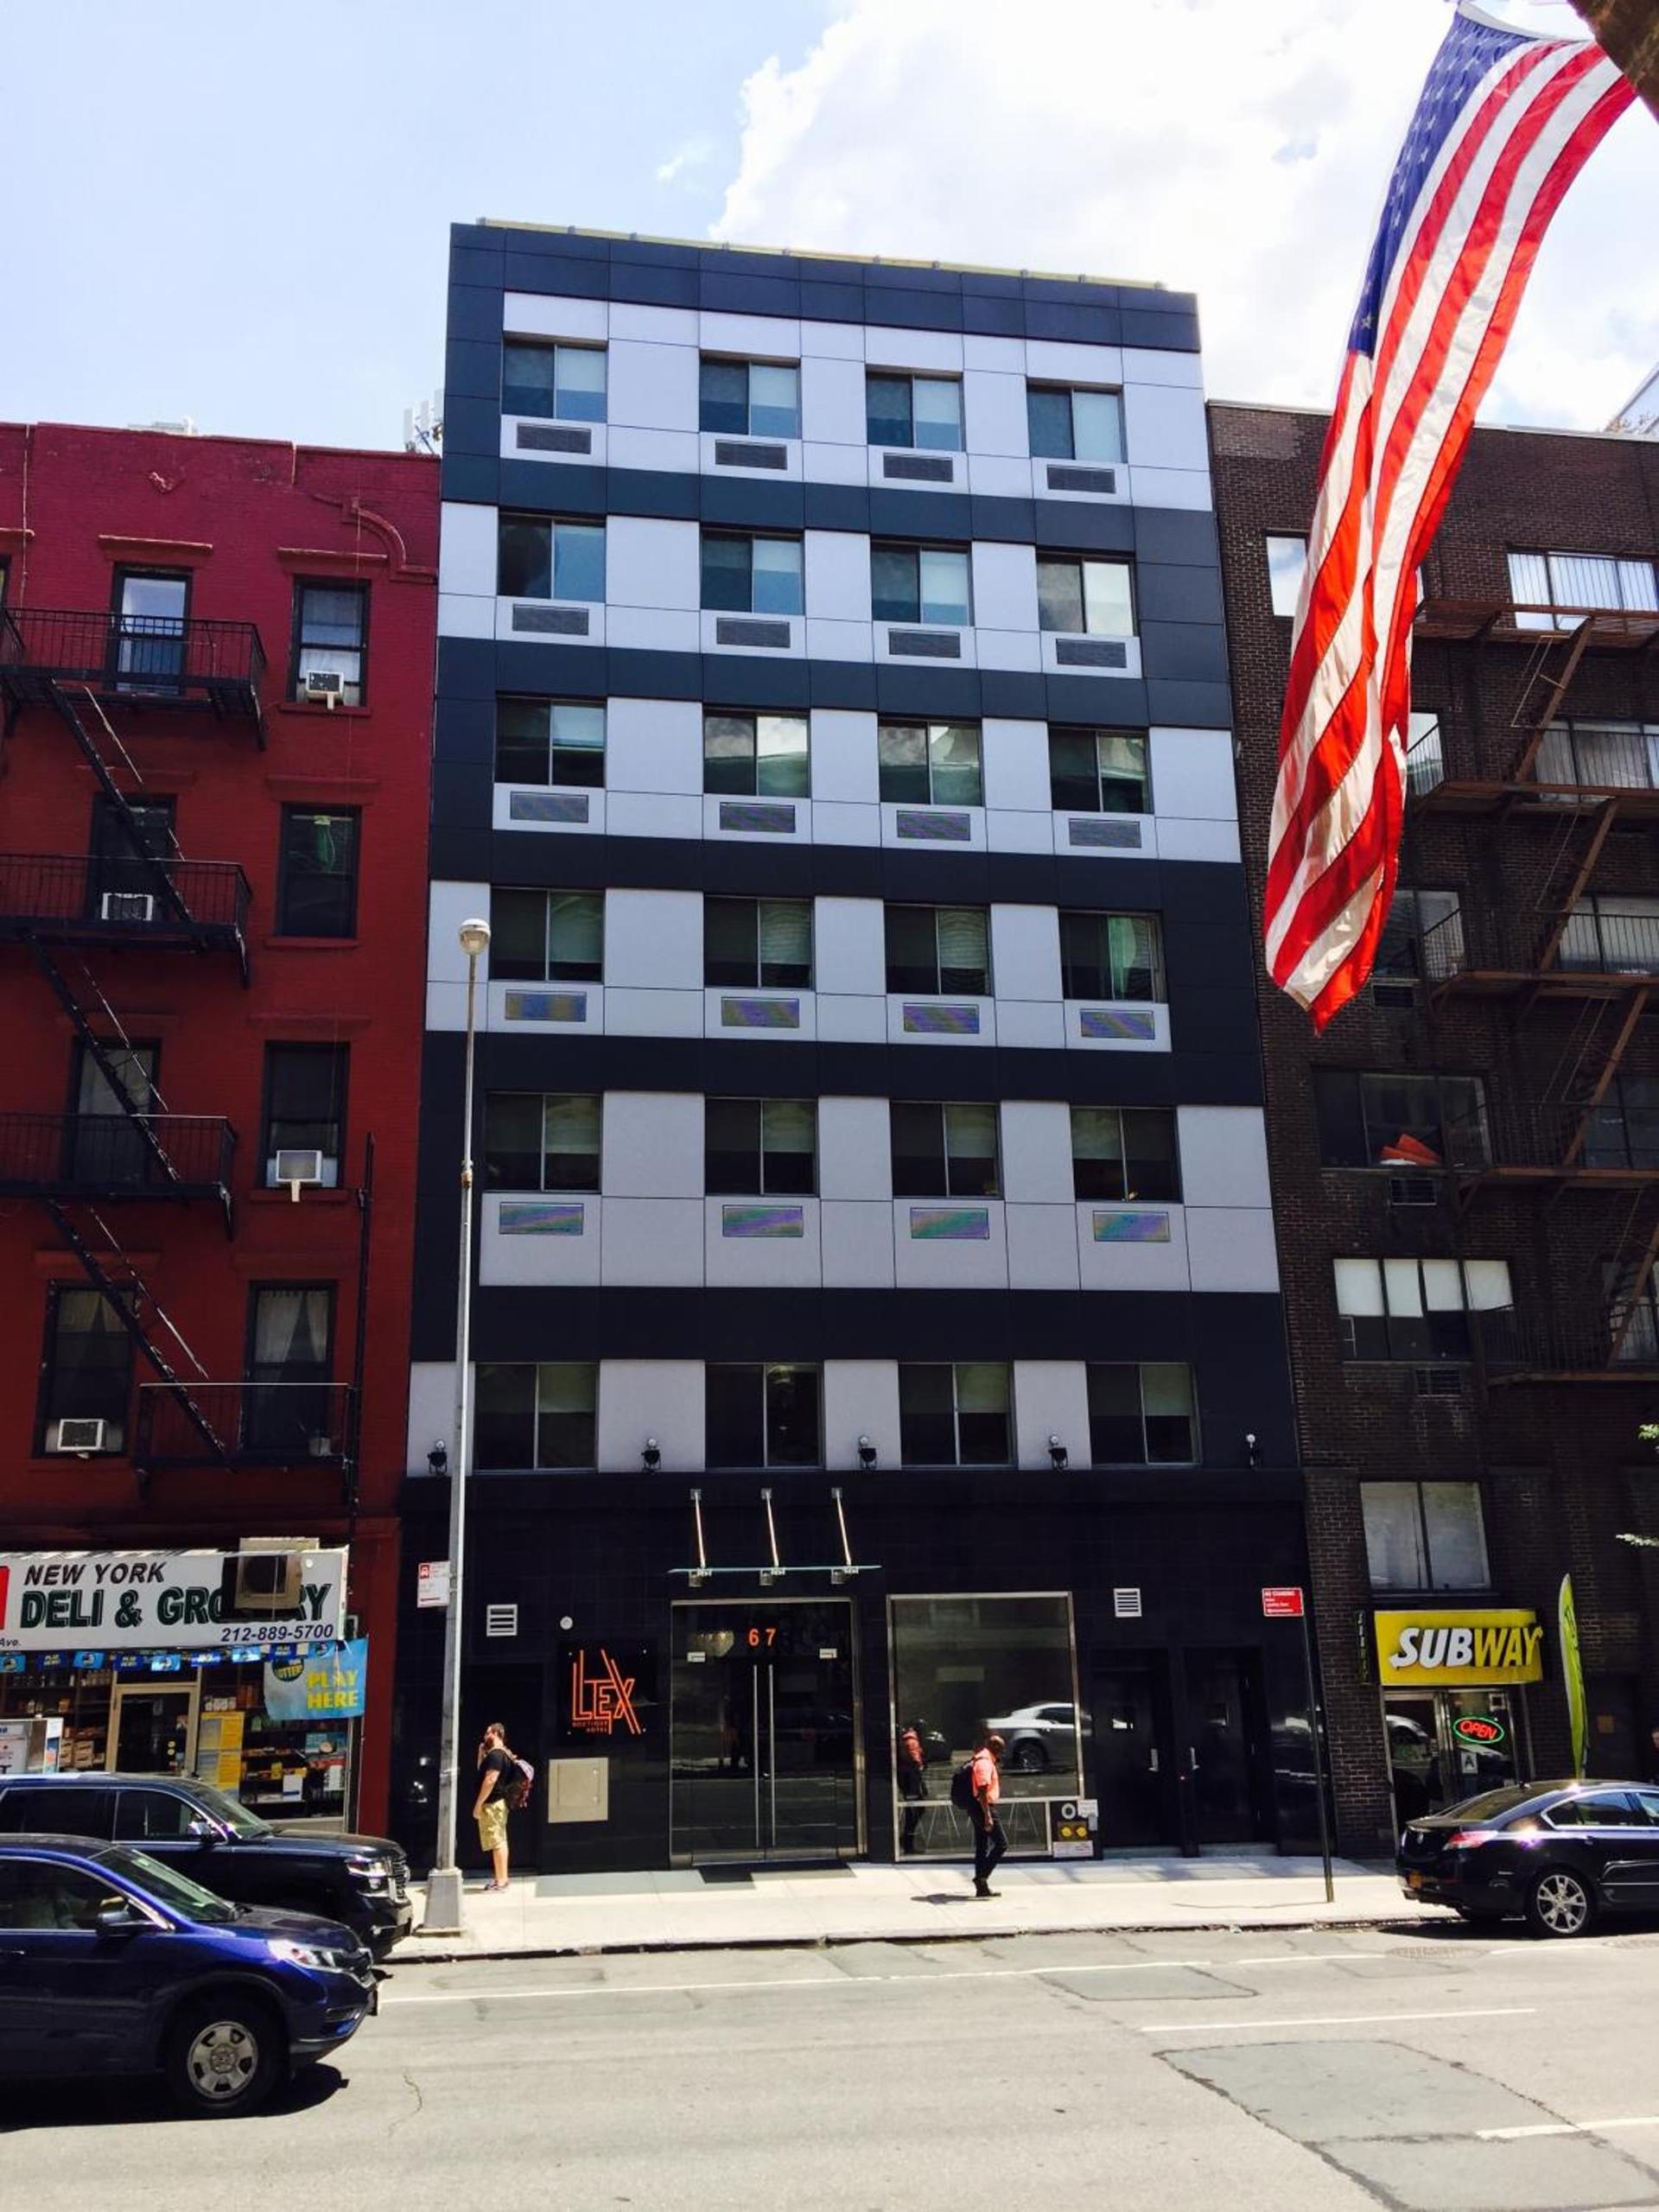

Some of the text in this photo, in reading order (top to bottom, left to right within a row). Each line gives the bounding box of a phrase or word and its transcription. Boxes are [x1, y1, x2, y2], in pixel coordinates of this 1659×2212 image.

[24, 1561, 167, 1586] NEW YORK
[20, 1589, 105, 1629] DELI
[114, 1589, 143, 1628] &
[221, 1624, 334, 1642] 212-889-5700
[748, 1628, 776, 1646] 67
[1389, 1625, 1543, 1669] SUBWAY
[307, 1669, 359, 1689] PLAY
[307, 1691, 359, 1710] HERE
[572, 1649, 642, 1735] LEX
[1459, 1720, 1498, 1739] OPEN
[1465, 1755, 1475, 1768] A
